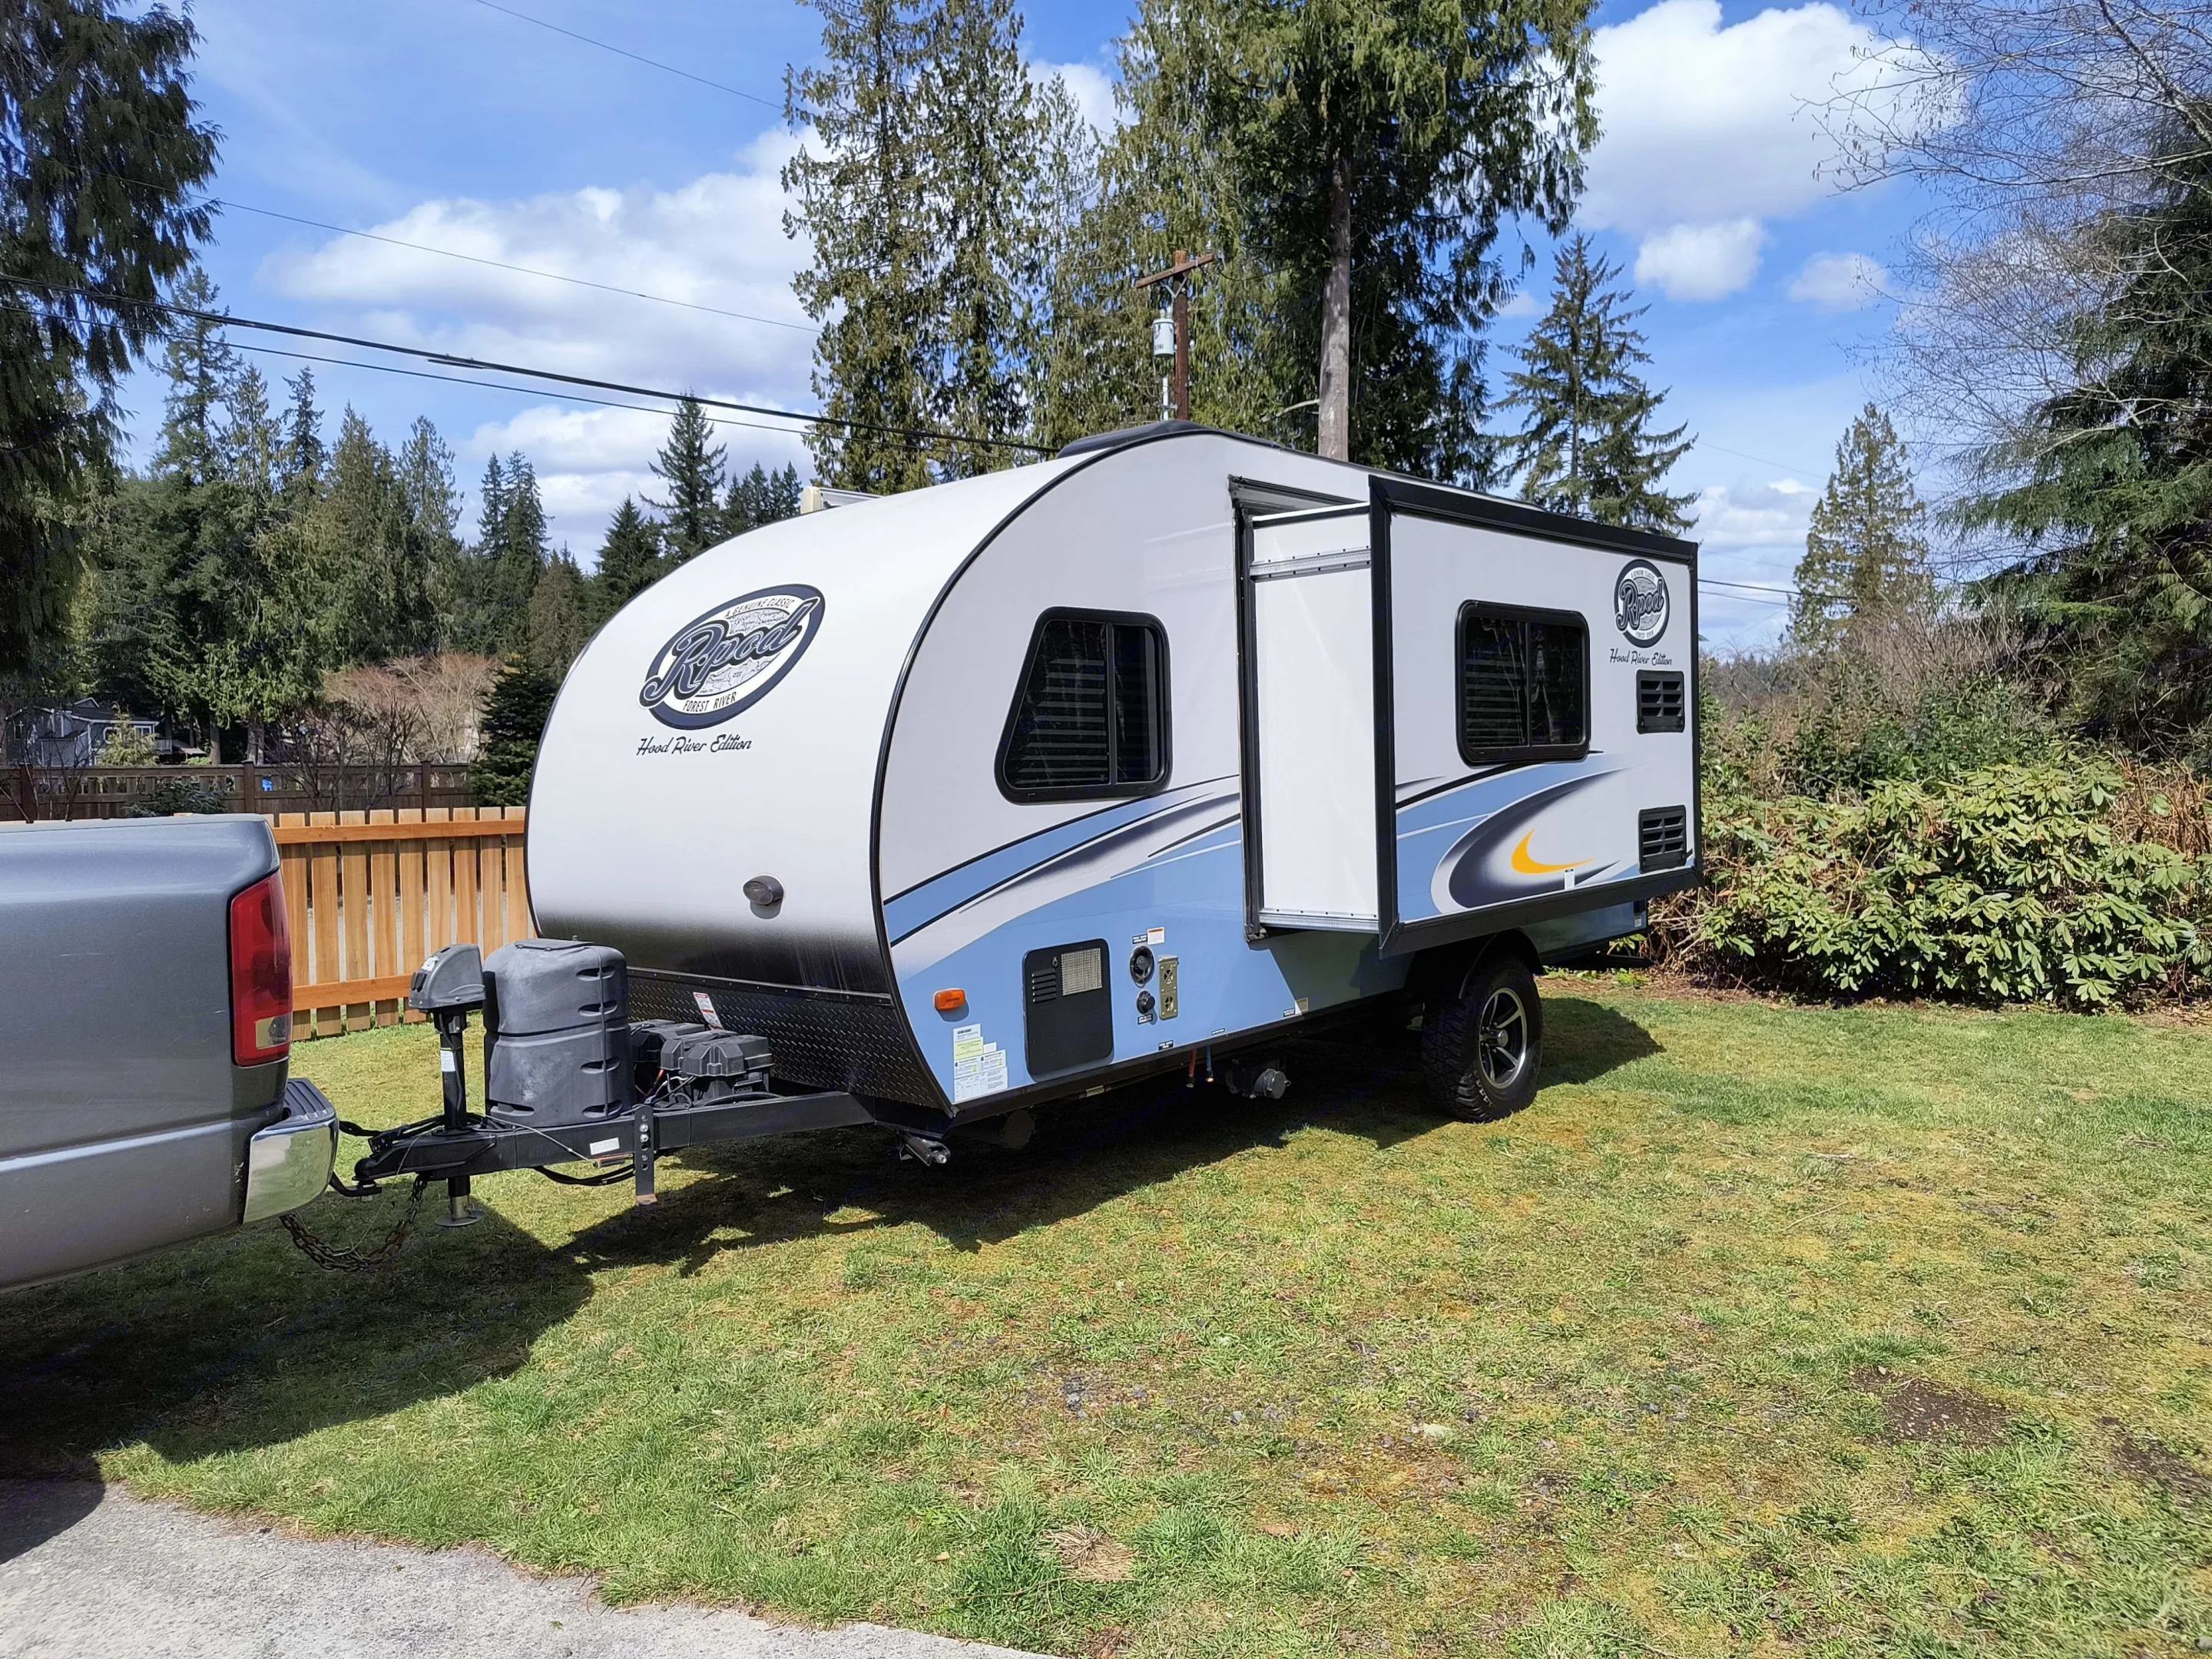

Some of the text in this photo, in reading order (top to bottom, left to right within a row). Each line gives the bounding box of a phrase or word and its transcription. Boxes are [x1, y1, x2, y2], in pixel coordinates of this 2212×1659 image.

[732, 599, 767, 615] GENUINE
[767, 598, 795, 609] CLASSIC
[1610, 648, 1672, 666] Hood River Edition
[683, 691, 737, 713] FOREST RIVER
[636, 733, 752, 756] Hood River Edition
